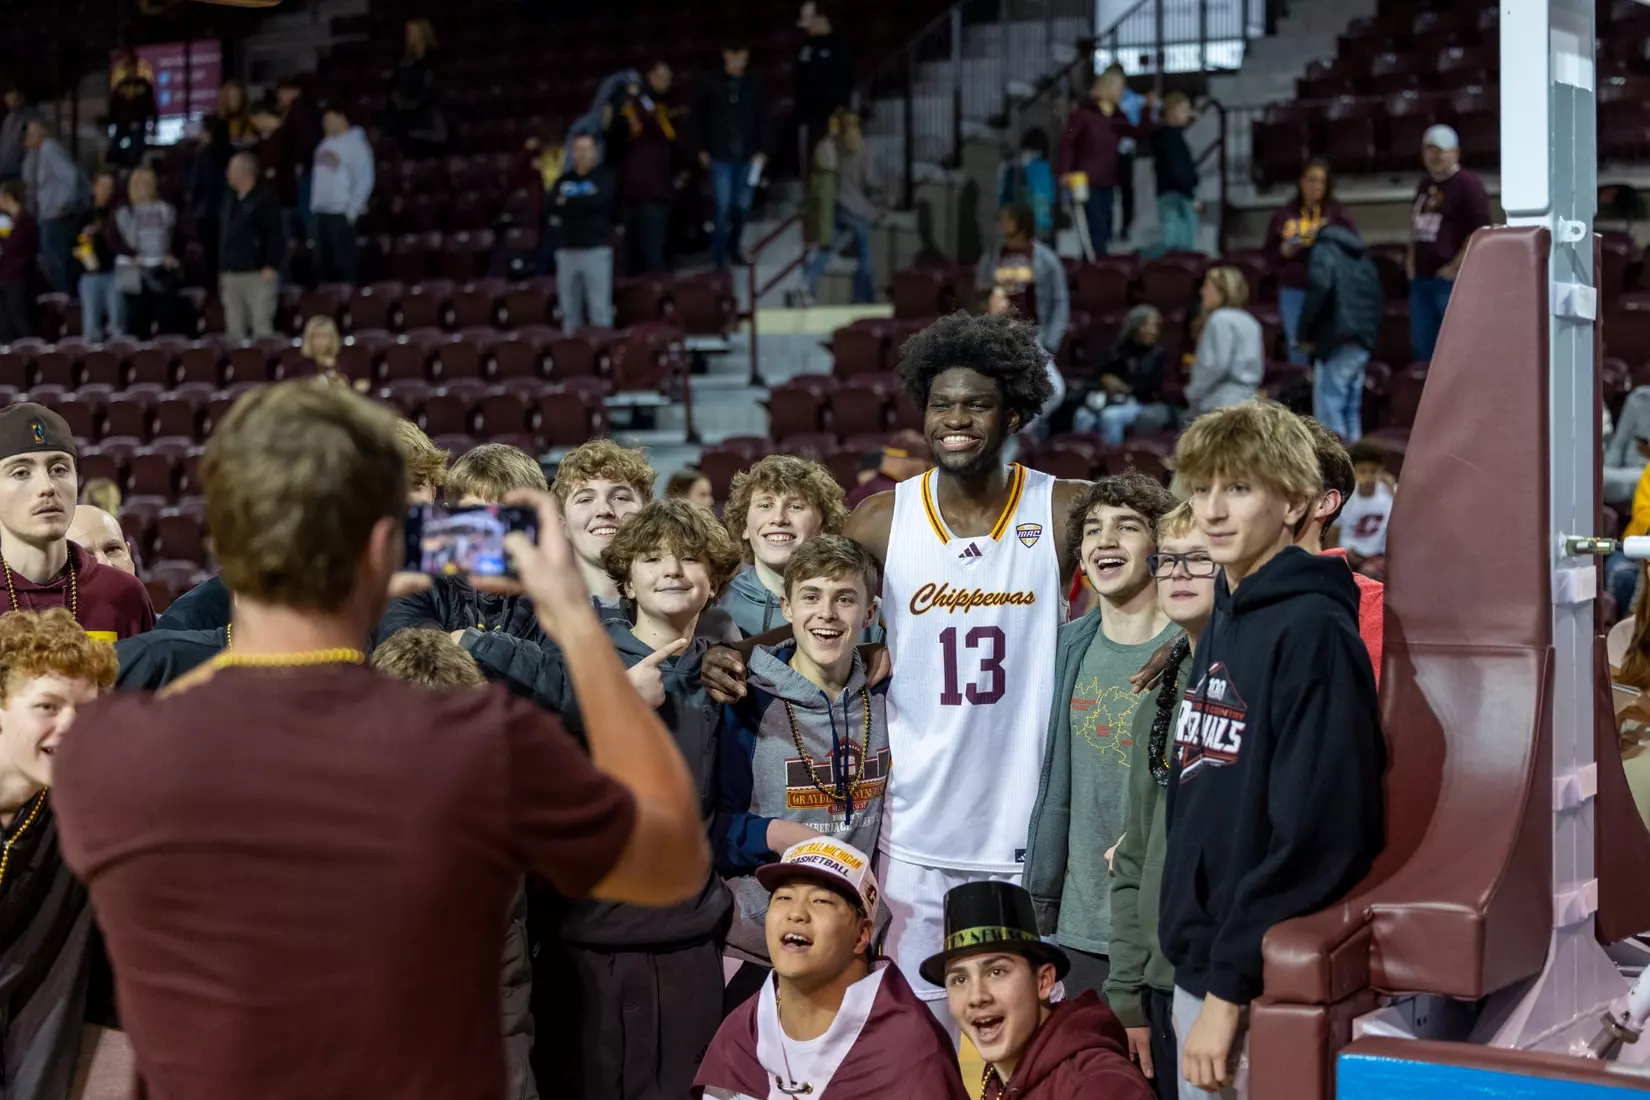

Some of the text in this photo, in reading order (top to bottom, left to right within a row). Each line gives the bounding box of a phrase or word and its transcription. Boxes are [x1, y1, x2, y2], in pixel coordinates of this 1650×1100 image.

[1018, 529, 1041, 538] MAC
[909, 582, 1036, 616] Chippewas
[939, 625, 1006, 706] 13
[790, 855, 850, 877] BASKETBALL
[822, 843, 864, 870] MICHIGAN
